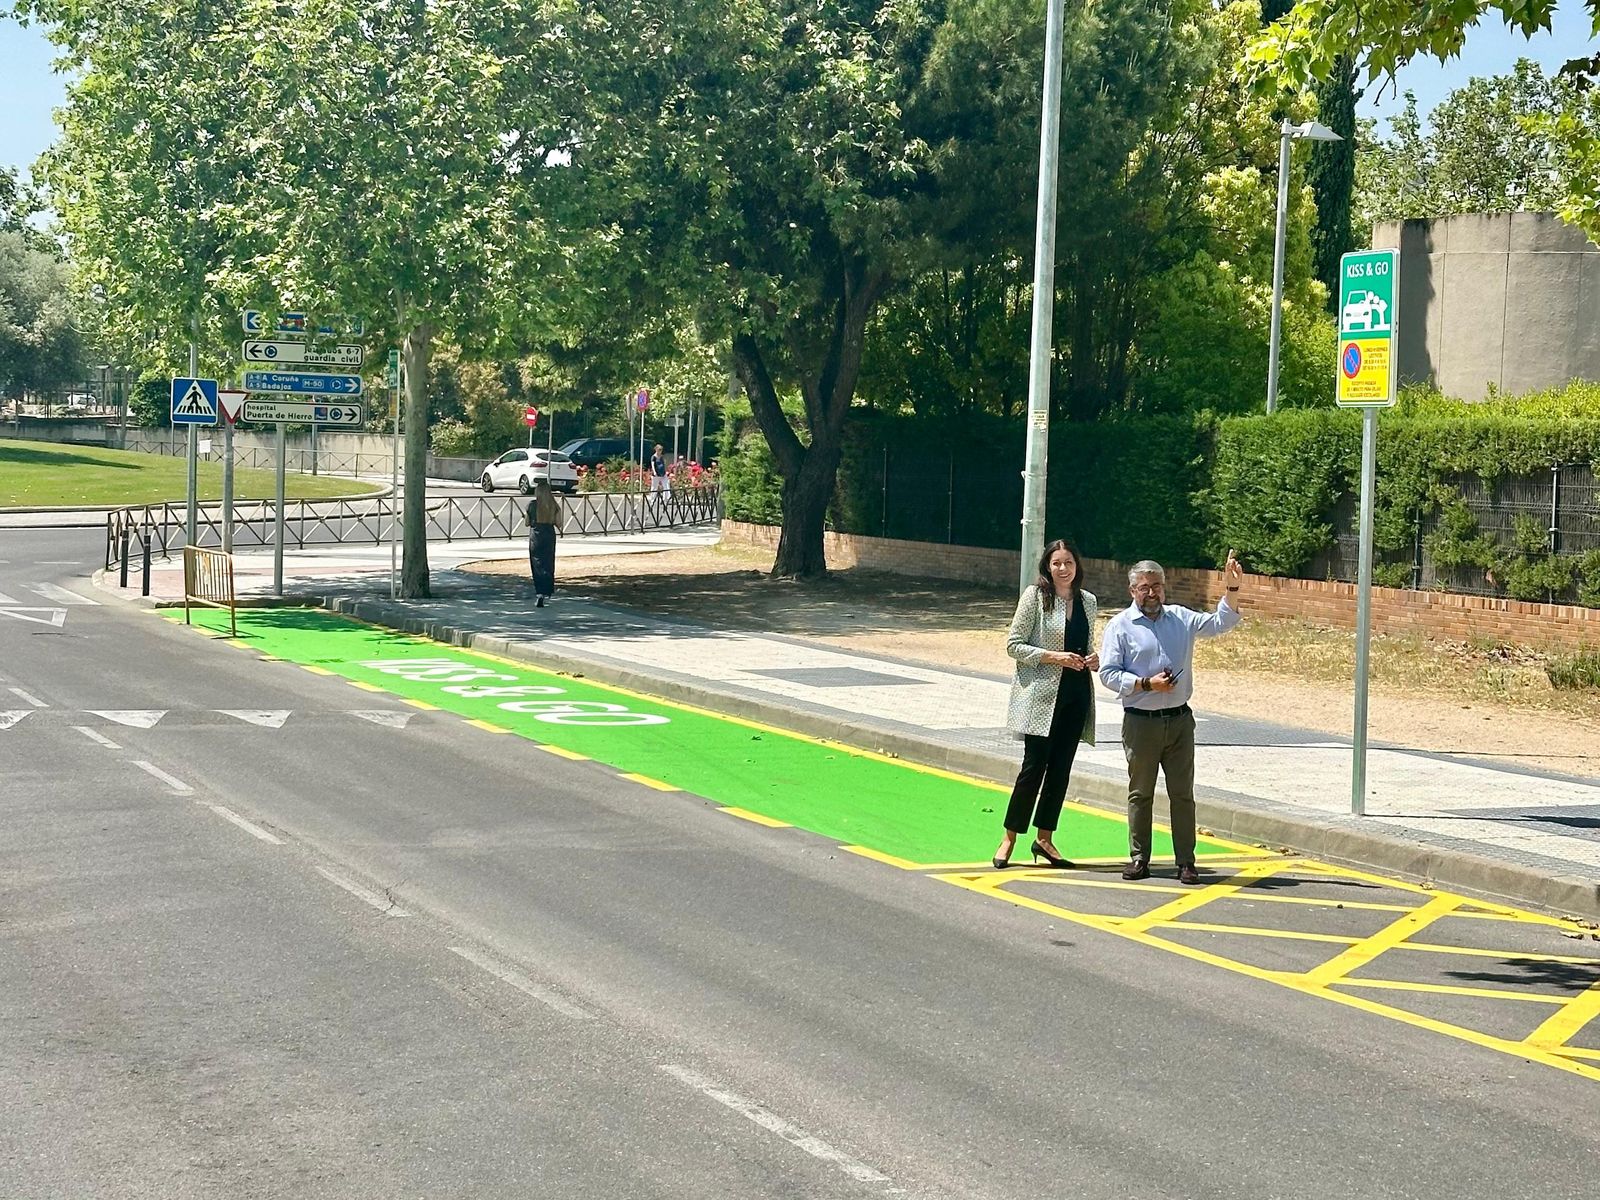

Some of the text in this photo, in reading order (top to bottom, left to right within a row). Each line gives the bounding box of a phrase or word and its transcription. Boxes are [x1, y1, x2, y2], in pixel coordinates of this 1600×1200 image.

[1346, 261, 1389, 278] KISS & GO
[271, 374, 299, 382] Coruña
[262, 382, 292, 390] Badajoz
[246, 411, 273, 419] Puerta
[288, 412, 313, 420] Hierro
[496, 701, 672, 726] GO
